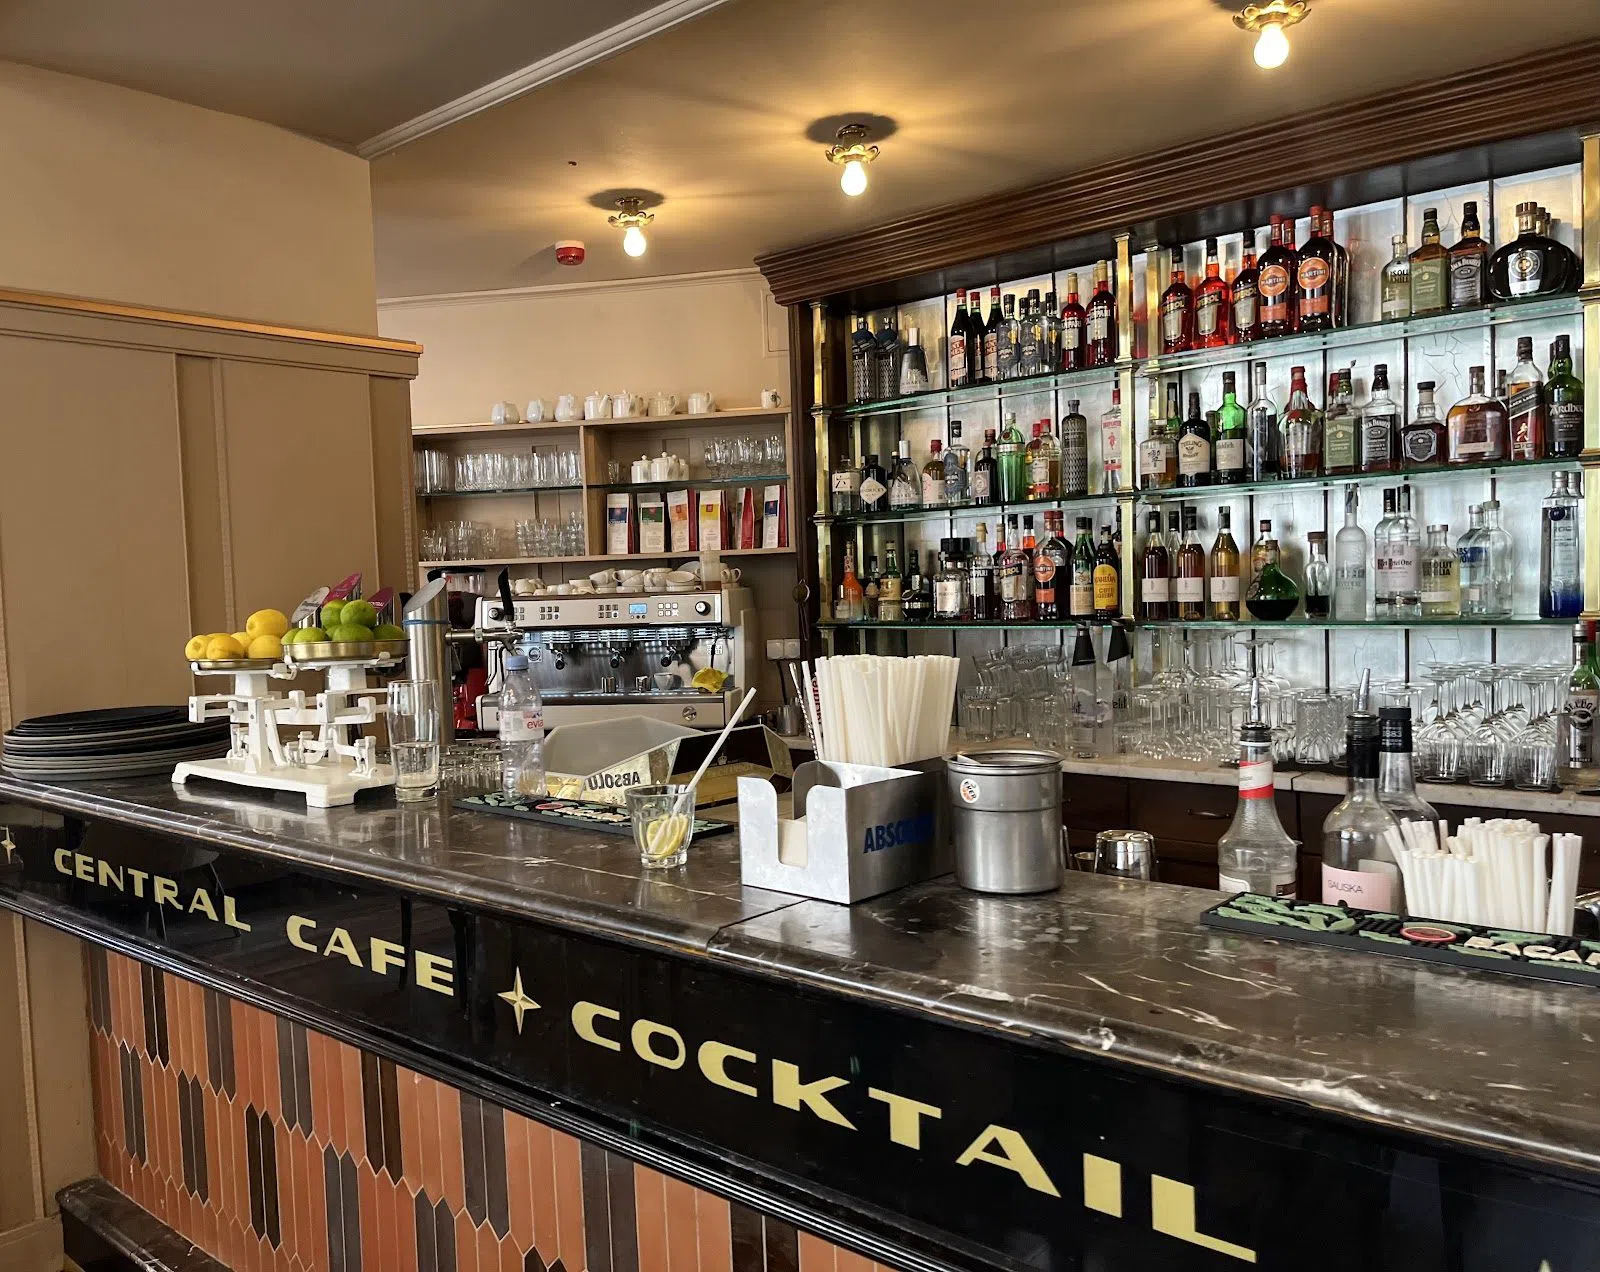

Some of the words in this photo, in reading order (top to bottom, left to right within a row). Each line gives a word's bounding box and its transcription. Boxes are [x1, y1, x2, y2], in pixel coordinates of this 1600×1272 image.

[863, 813, 936, 854] ABSO
[53, 847, 252, 932] CENTRAL
[285, 914, 455, 997] CAFE
[570, 1000, 1257, 1263] COCKTAIL
